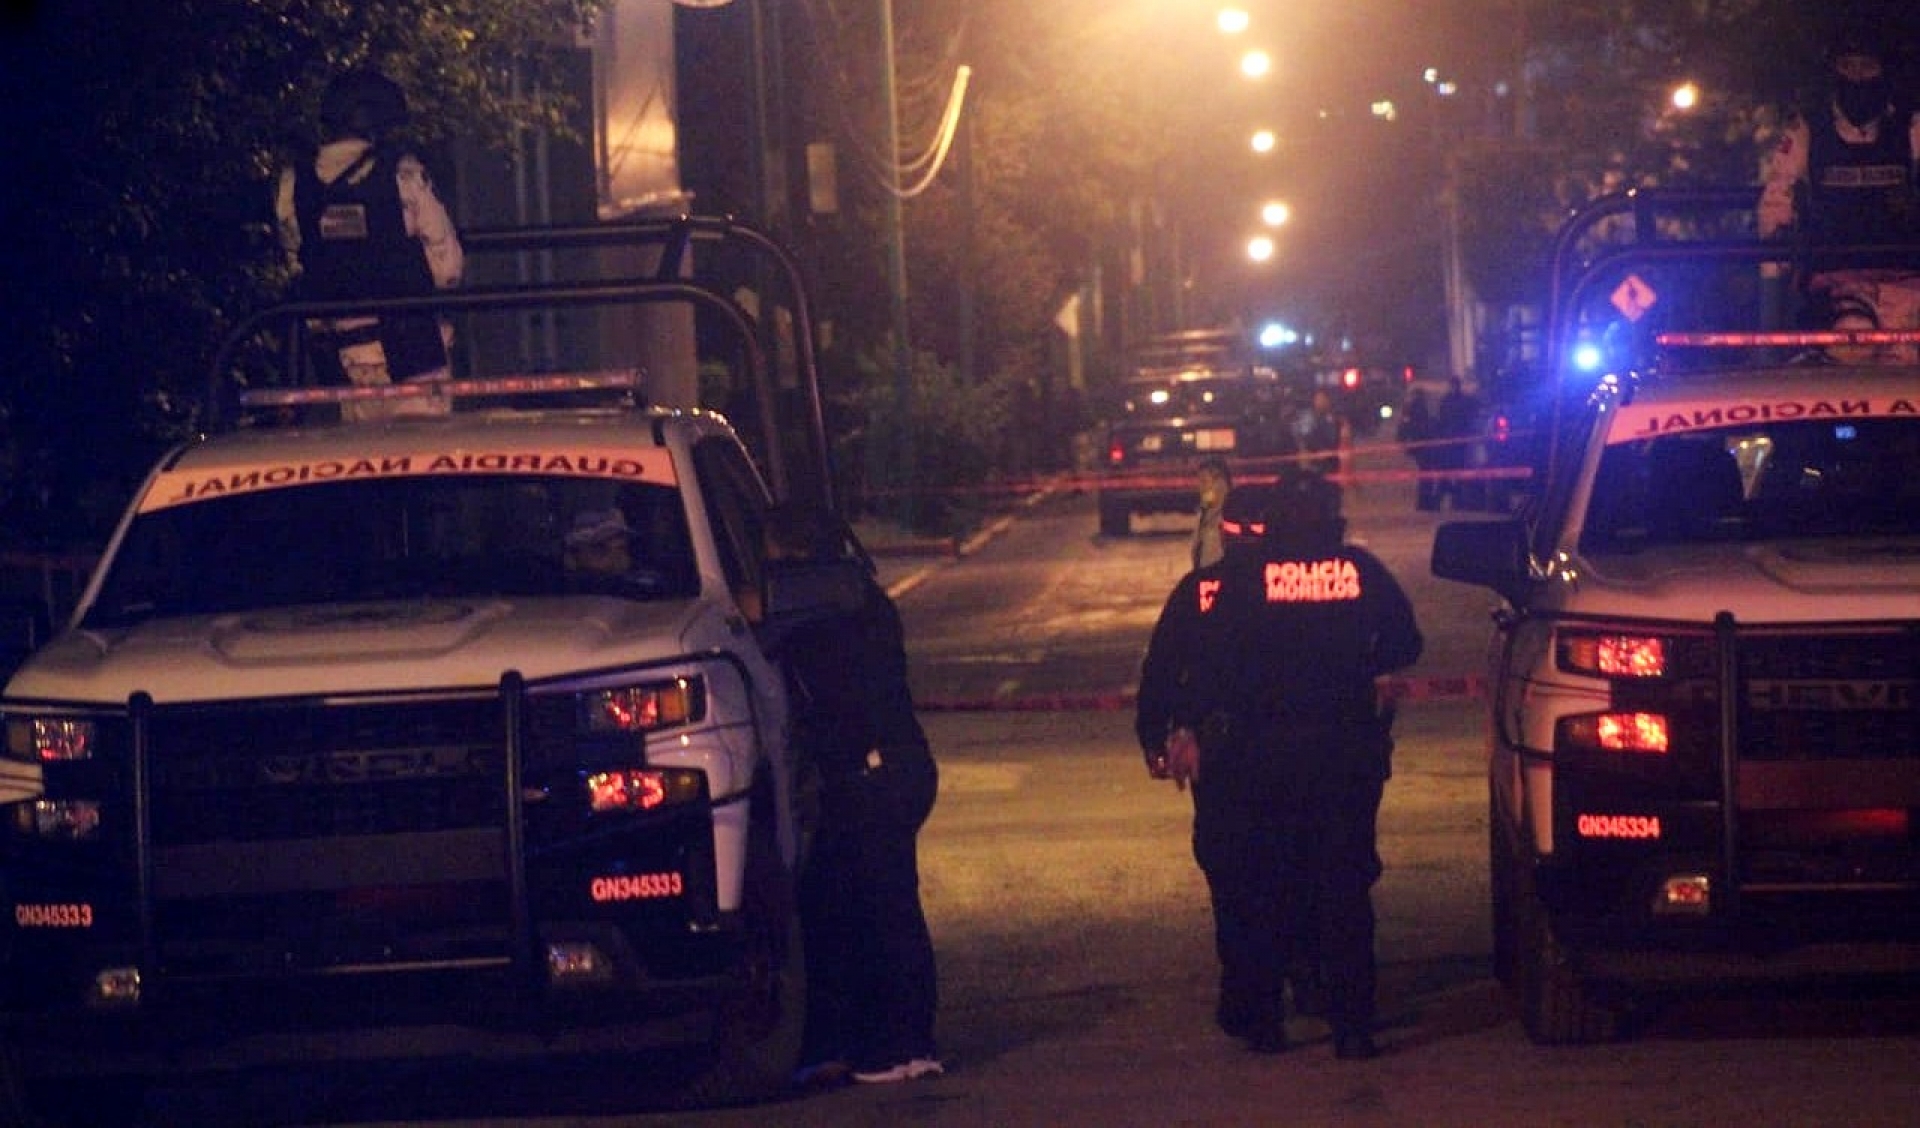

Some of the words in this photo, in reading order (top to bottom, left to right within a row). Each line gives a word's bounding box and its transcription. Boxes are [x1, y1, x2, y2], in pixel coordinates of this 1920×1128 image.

[1266, 578, 1361, 602] MORELOS
[1577, 813, 1661, 838] GN345334
[591, 871, 682, 901] GN345333
